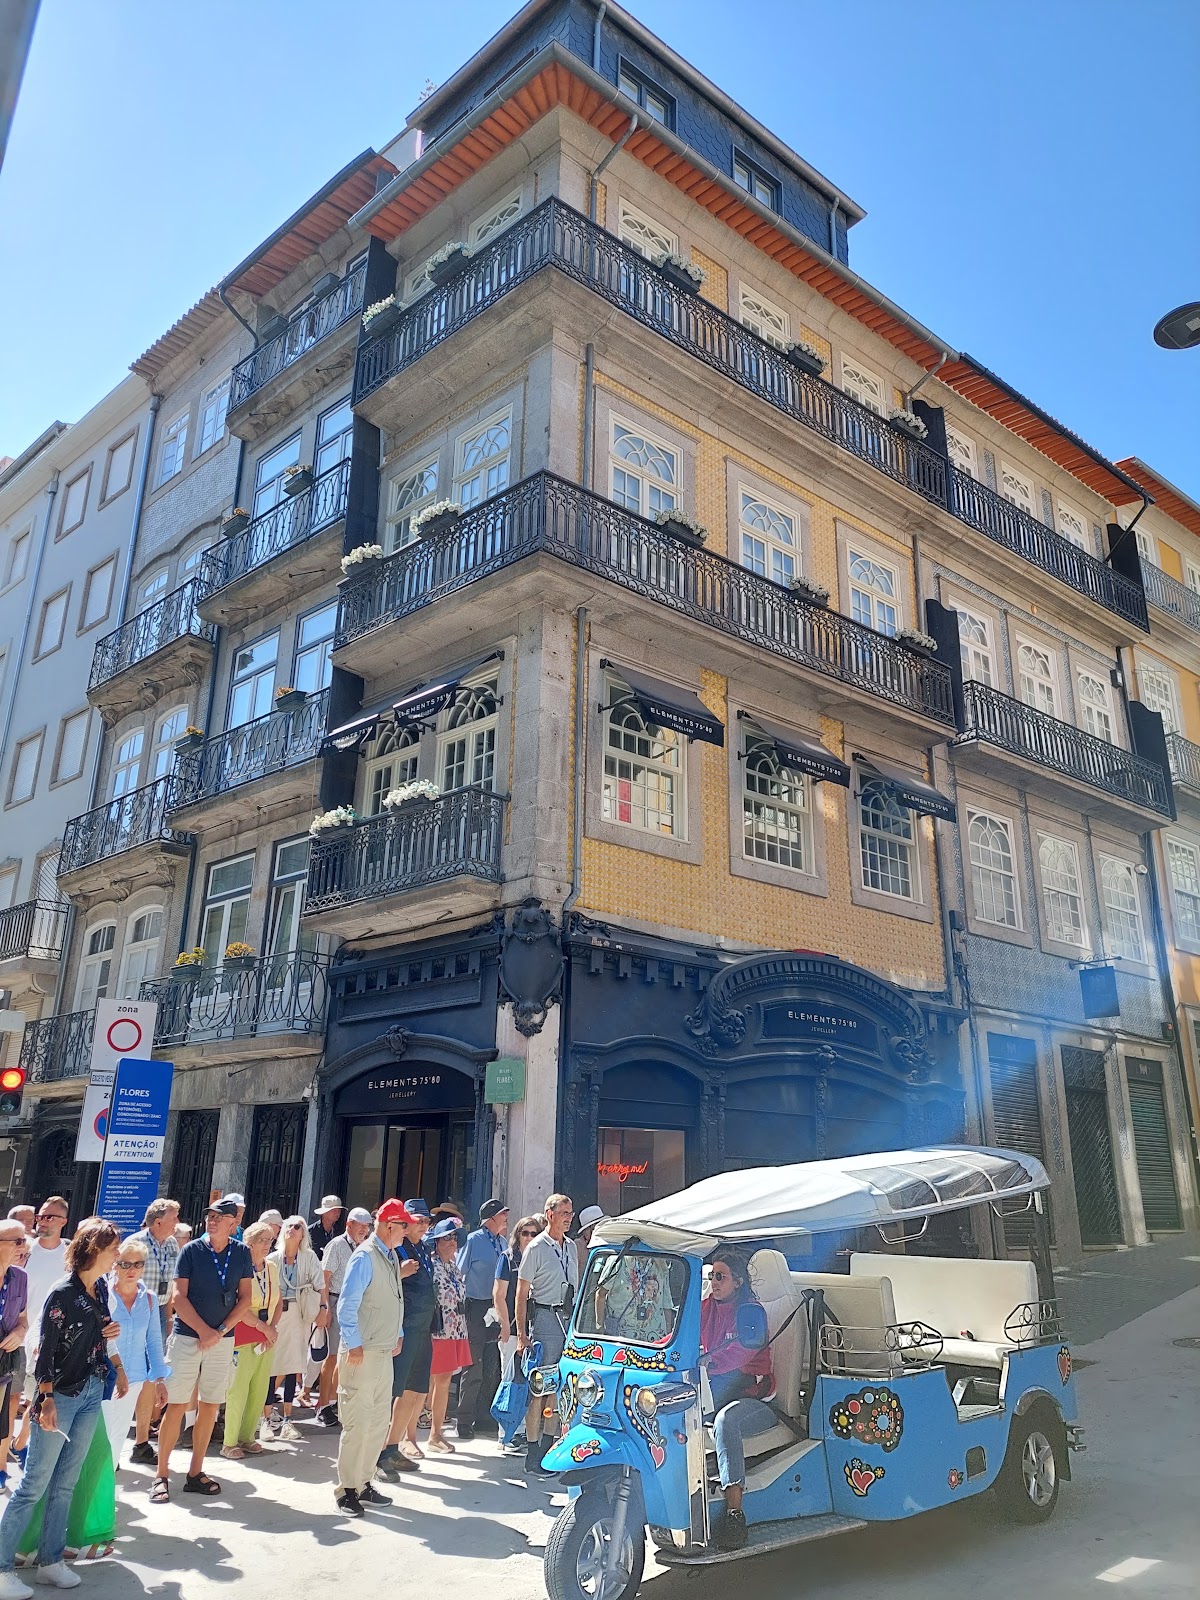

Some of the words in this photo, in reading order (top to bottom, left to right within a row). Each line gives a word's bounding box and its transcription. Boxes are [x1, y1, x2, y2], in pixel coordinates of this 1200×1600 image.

[650, 707, 694, 727] ELEMENTS
[695, 722, 713, 734] 75'80
[671, 723, 694, 734] JEWELLERY
[787, 753, 826, 771] ELEMENTS
[826, 766, 841, 776] 75'80
[903, 793, 935, 808] ELEMENTS
[788, 1010, 837, 1025] ELEMENTS
[838, 1019, 857, 1028] 75'80
[811, 1026, 837, 1034] JEWELLERY
[368, 1077, 418, 1089] ELEMENTS
[419, 1075, 441, 1085] 75'80
[119, 1088, 150, 1098] FLORES
[388, 1091, 417, 1099] JEWELLERY
[114, 1140, 158, 1148] ATENÇÃO!
